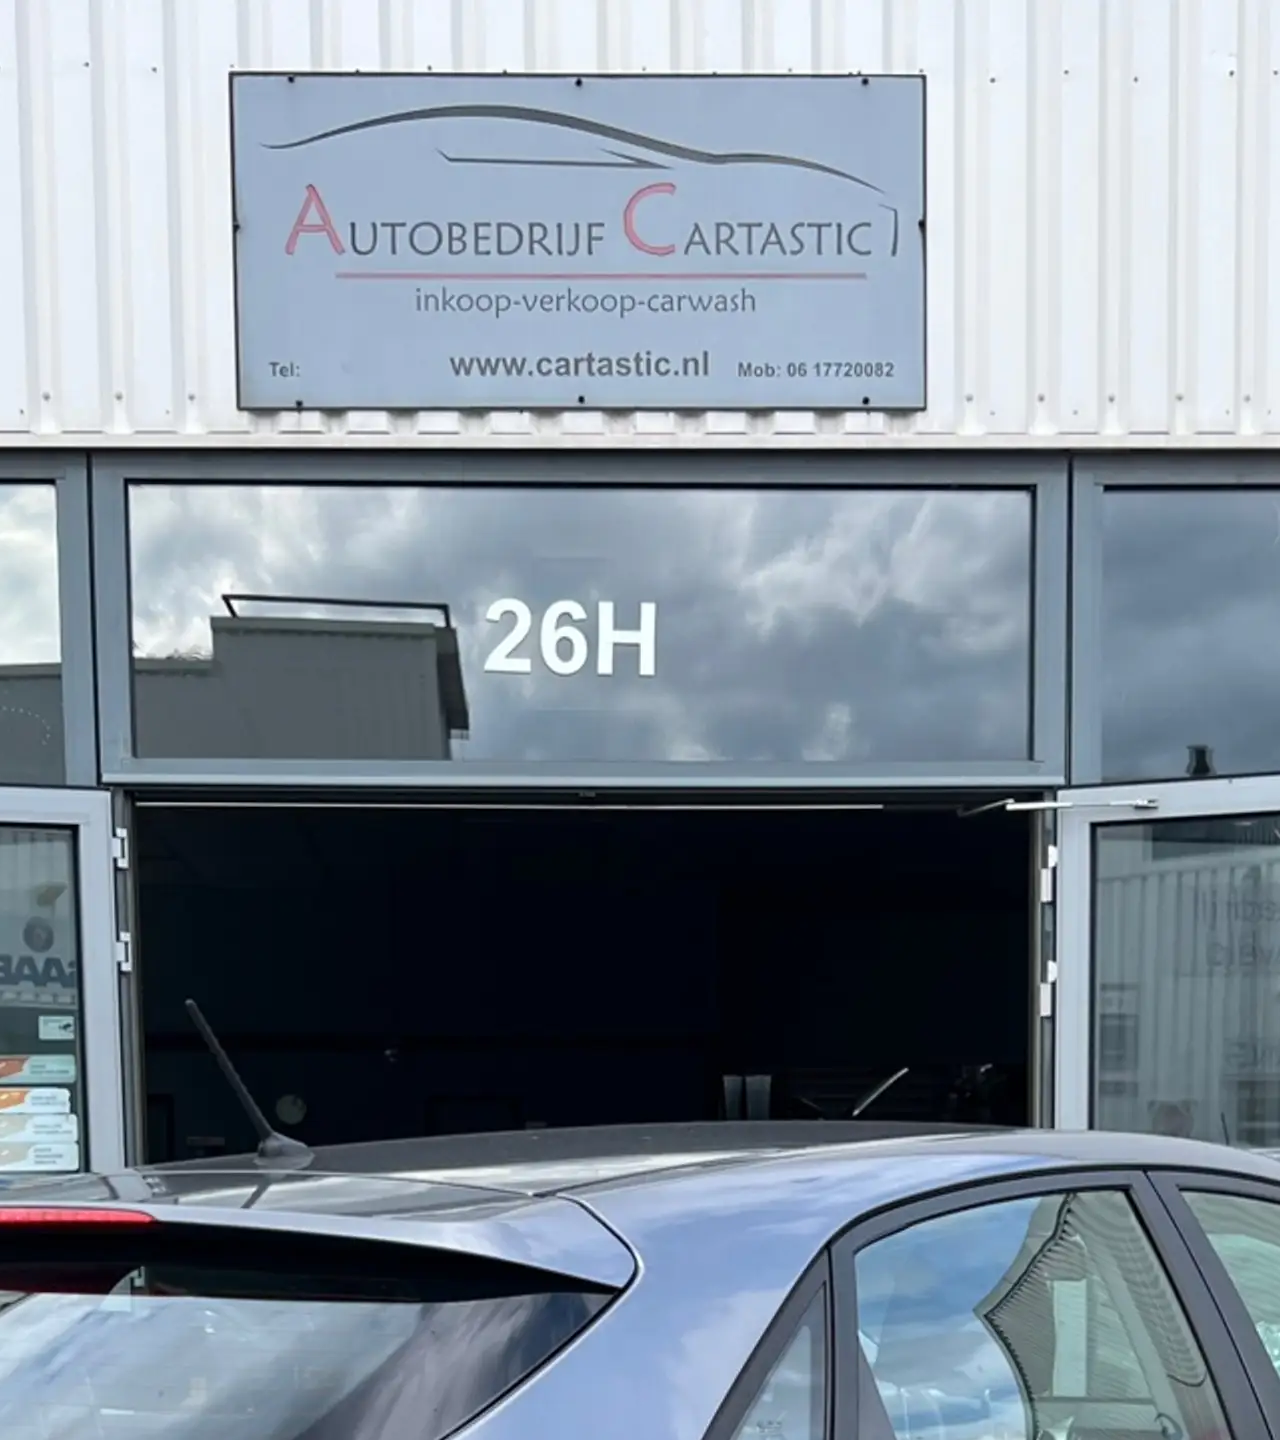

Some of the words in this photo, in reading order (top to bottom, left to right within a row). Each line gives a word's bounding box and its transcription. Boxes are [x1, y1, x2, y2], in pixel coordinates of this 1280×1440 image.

[285, 182, 606, 258] AUTOBEDRIJF
[623, 182, 873, 258] CARTASTIC
[415, 285, 757, 319] inkoop-verkoop-carwash
[269, 361, 301, 379] Tel:
[449, 350, 711, 380] www.cartastic.nl
[737, 361, 782, 380] Mob:
[786, 361, 809, 379] 06
[813, 361, 896, 379] 17720082
[483, 598, 656, 677] 26H
